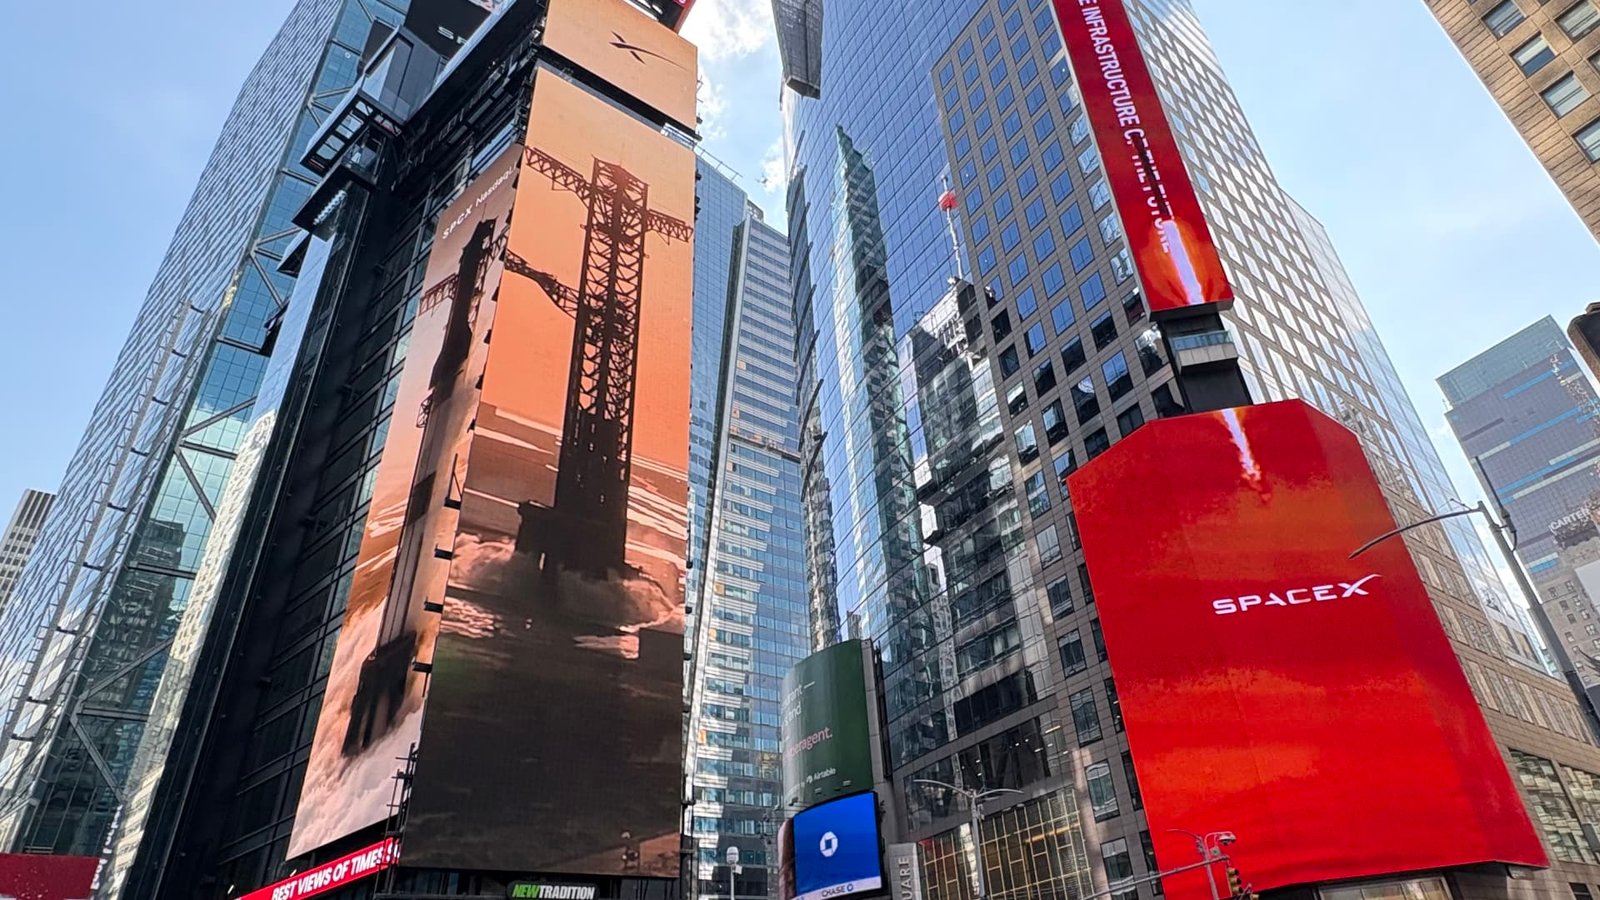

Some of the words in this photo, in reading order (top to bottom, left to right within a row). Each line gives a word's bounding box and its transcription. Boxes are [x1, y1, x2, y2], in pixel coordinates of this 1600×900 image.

[1081, 6, 1140, 127] INFRASTRUCTURE
[442, 204, 473, 239] SPCX
[1212, 573, 1383, 615] SPACEX
[271, 880, 298, 900] BEST
[297, 867, 333, 896] VIEWS
[332, 859, 351, 882] OF
[821, 885, 846, 898] CHASE
